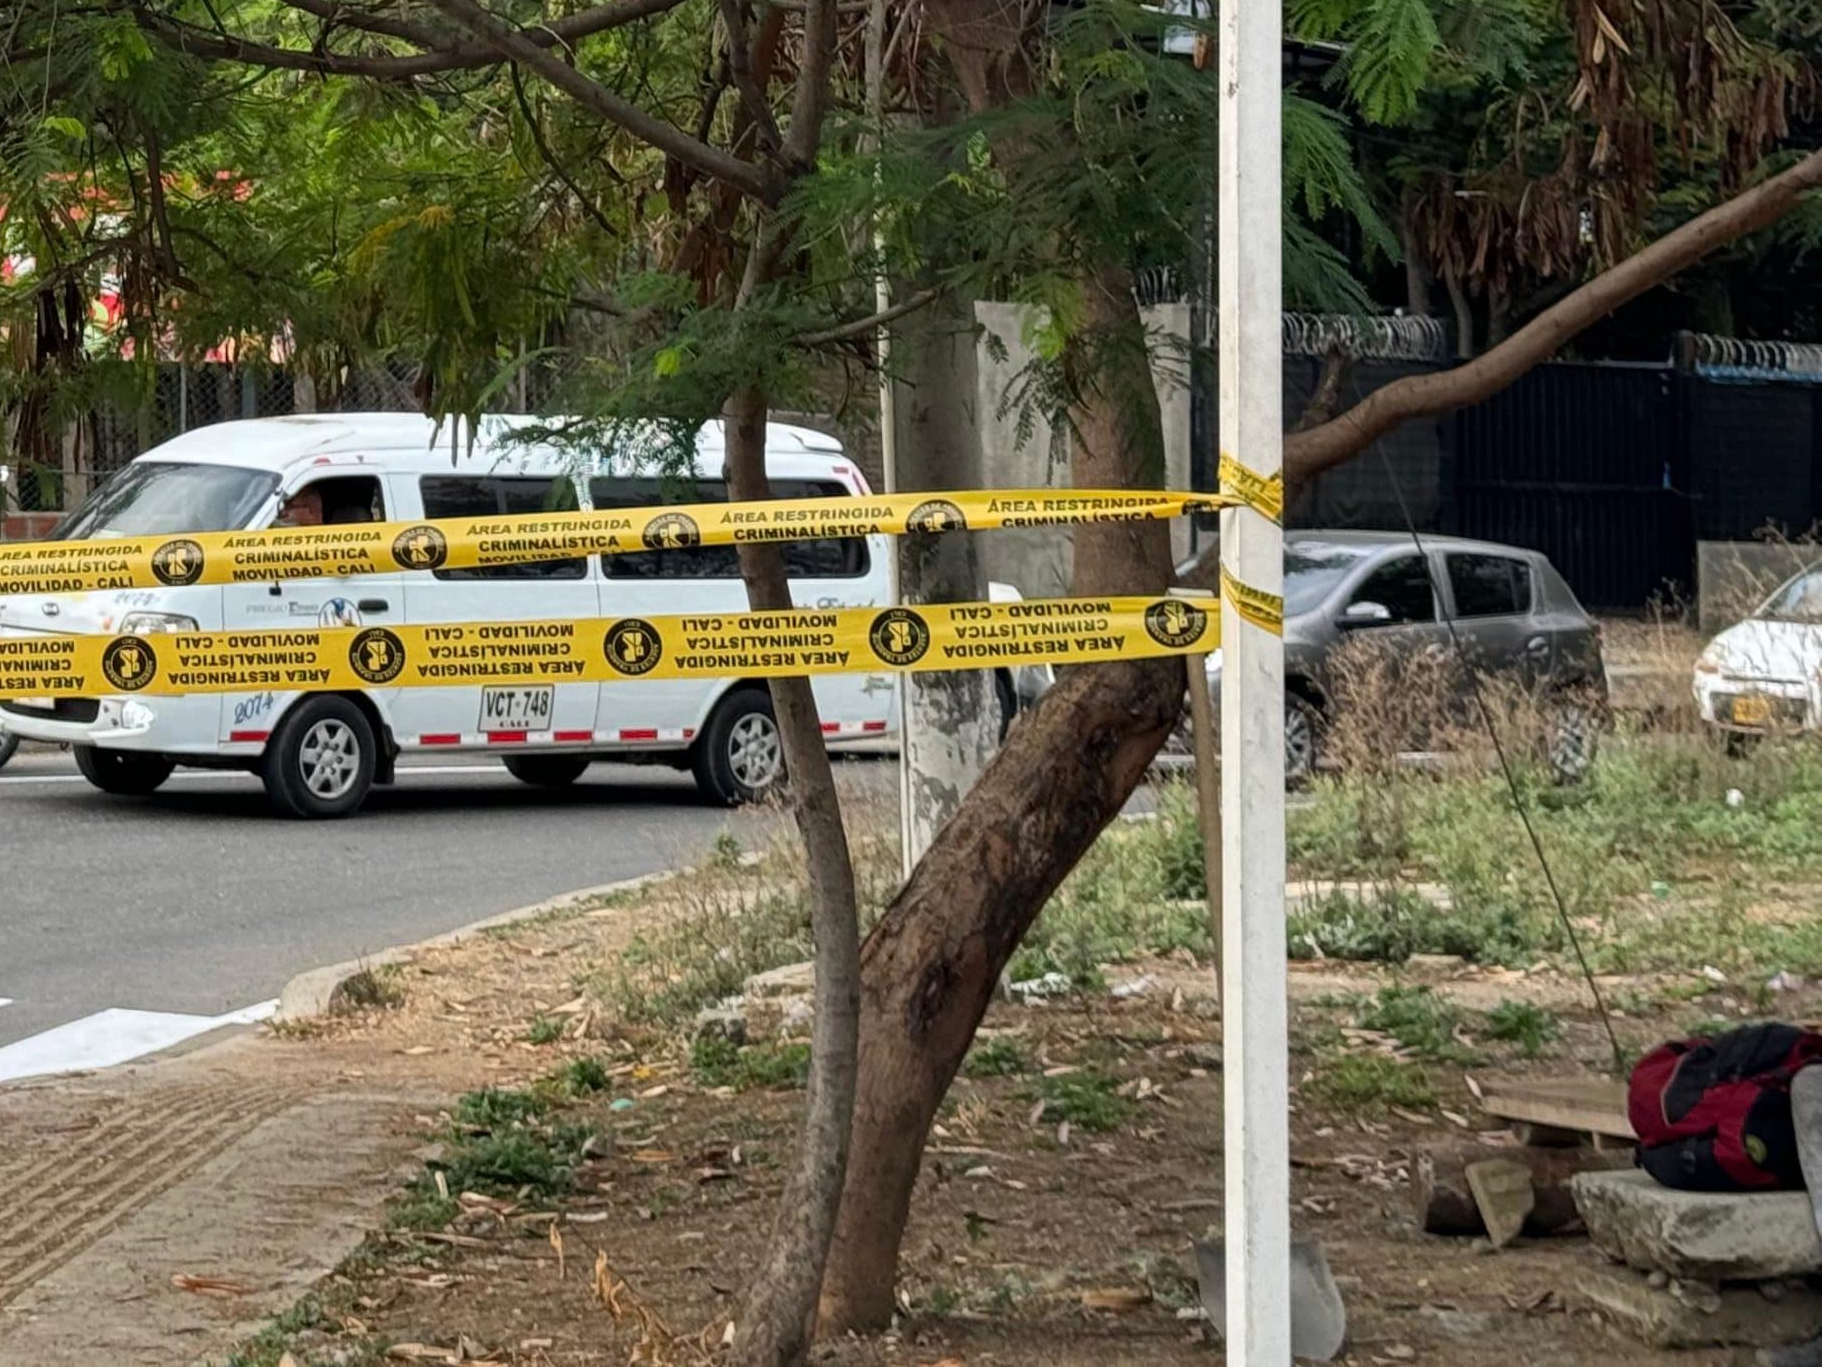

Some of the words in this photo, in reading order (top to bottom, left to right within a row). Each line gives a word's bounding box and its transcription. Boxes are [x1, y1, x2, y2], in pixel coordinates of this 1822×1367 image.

[988, 497, 1037, 513] ÁREA
[721, 510, 767, 524] ÁREA
[773, 506, 894, 522] RESTRINGIDA
[466, 523, 511, 535] ÁREA
[517, 518, 632, 533] RESTRINGIDA
[733, 523, 882, 541] CRIMINALÍSTICA
[223, 536, 266, 548] ÁREA
[272, 531, 382, 546] RESTRINGIDA
[479, 534, 620, 552] CRIMINALÍSTICA
[37, 545, 142, 558] RESTRINGIDA
[234, 546, 369, 565] CRIMINALÍSTICA
[0, 559, 130, 576] CRIMINALÍSTICA
[232, 565, 323, 581] MOVILIDAD
[337, 563, 376, 576] CALI
[97, 576, 134, 588] CALI
[950, 607, 992, 620] CALI
[1008, 603, 1111, 617] MOVILIDAD
[683, 619, 722, 631] CALI
[739, 615, 836, 630] MOVILIDAD
[956, 620, 1108, 639] CRIMINALÍSTICA
[426, 628, 463, 640] CALI
[479, 625, 573, 639] MOVILIDAD
[176, 637, 213, 649] CALI
[228, 634, 319, 648] MOVILIDAD
[687, 634, 834, 651] CRIMINALÍSTICA
[944, 639, 1068, 658] RESTRINGIDA
[1074, 635, 1124, 652] ÁREA
[429, 643, 570, 660] CRIMINALÍSTICA
[801, 651, 849, 667] ÁREA
[180, 652, 316, 668] CRIMINALÍSTICA
[539, 661, 584, 675] ÁREA
[675, 653, 795, 668] RESTRINGIDA
[286, 669, 330, 684] ÁREA
[418, 662, 533, 677] RESTRINGIDA
[42, 676, 84, 691] ÁREA
[168, 671, 280, 685] RESTRINGIDA
[234, 691, 274, 725] 2074
